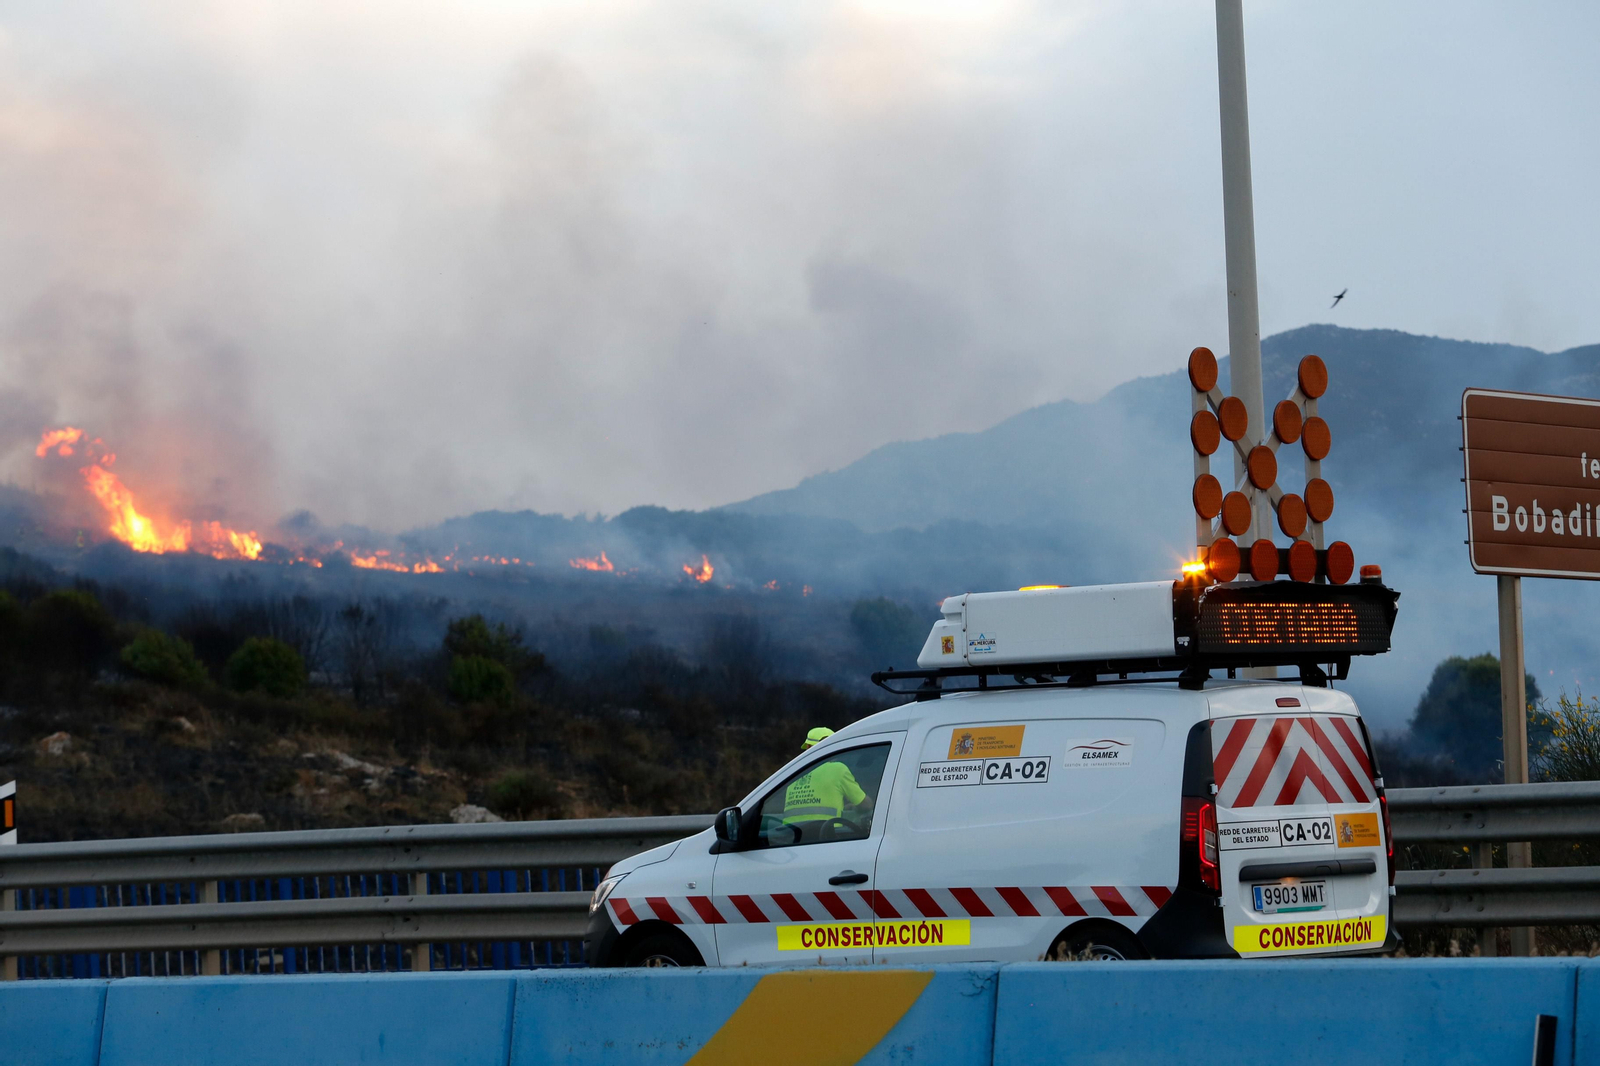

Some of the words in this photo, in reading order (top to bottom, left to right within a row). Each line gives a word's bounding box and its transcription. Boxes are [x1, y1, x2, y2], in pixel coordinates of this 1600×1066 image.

[1082, 751, 1119, 759] ELSAMEX
[920, 767, 932, 775] RED
[941, 765, 982, 773] CARRETERAS
[943, 773, 969, 781] ESTADO
[985, 760, 1047, 780] CA-02
[1219, 828, 1232, 836] RED
[1232, 827, 1241, 835] DE
[1242, 825, 1279, 834] CARRETERAS
[1282, 821, 1332, 842] CA-02
[1232, 836, 1244, 844] DEL
[1245, 835, 1269, 843] ESTADO
[1264, 886, 1298, 906] 9903
[1301, 885, 1324, 903] MMT
[801, 920, 943, 948] CONSERVACIÓN
[1259, 915, 1372, 949] CONSERVACIÓN
